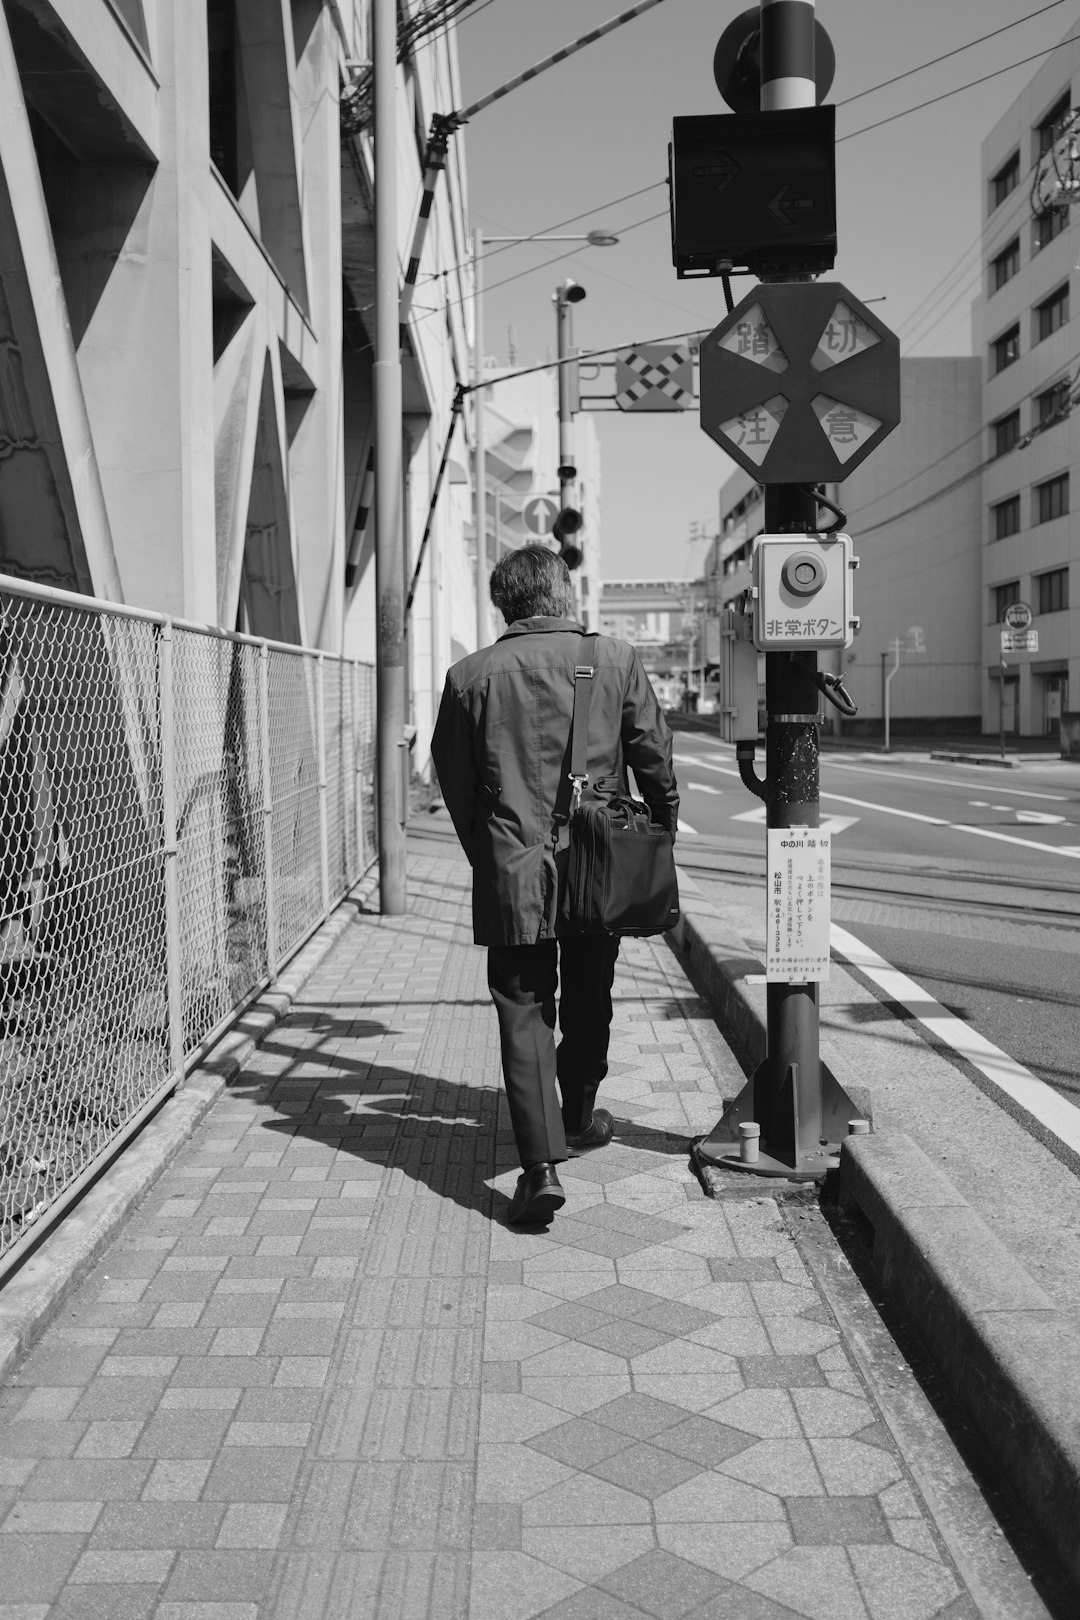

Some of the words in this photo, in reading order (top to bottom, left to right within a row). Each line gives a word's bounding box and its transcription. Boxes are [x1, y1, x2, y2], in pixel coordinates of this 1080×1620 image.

[736, 320, 858, 356] 踏切
[736, 410, 858, 446] 注意
[766, 618, 842, 636] 非常ボタン
[806, 874, 814, 922] 上のボタンを
